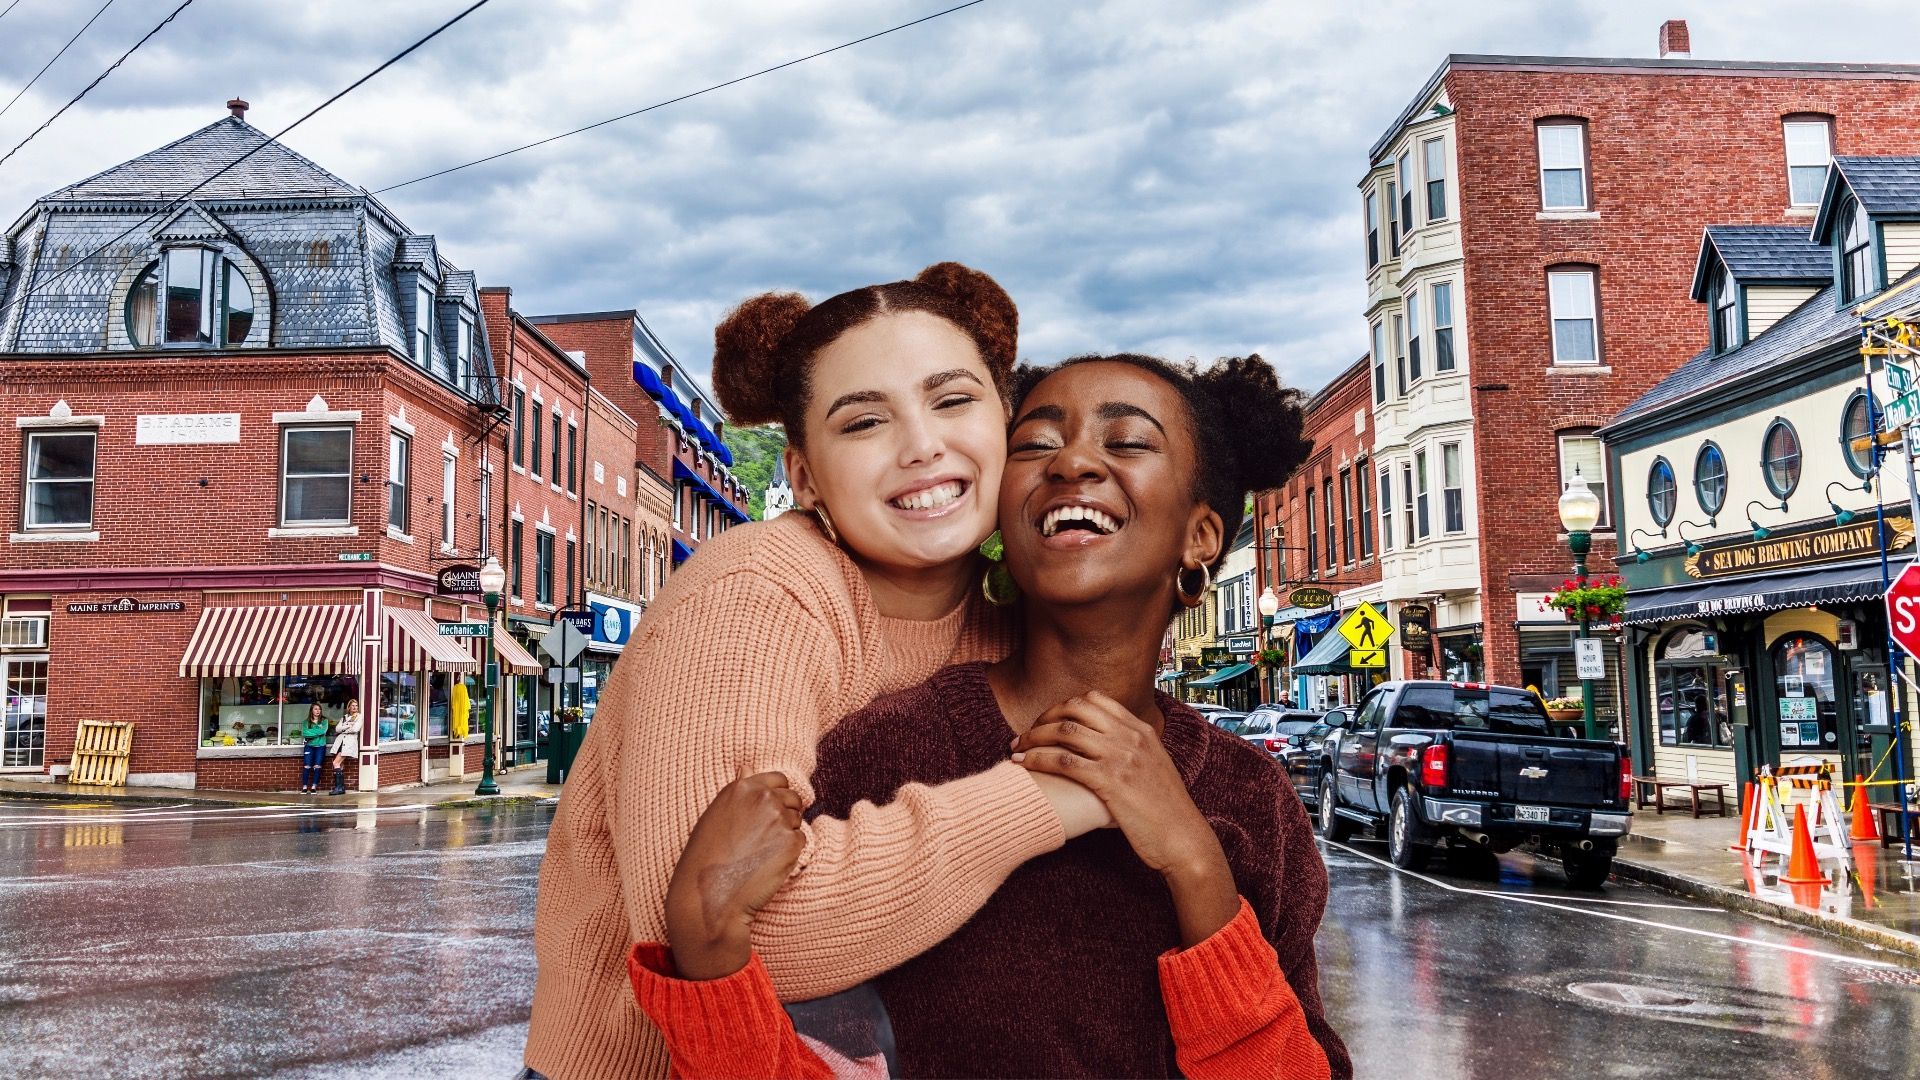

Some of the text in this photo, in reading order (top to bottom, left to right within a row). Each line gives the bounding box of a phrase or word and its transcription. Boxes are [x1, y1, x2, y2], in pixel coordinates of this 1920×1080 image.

[1886, 364, 1912, 391] Elm St
[1886, 393, 1920, 428] Main St
[1713, 527, 1873, 570] SEA DOG BREWING COMPANY
[451, 571, 480, 579] MAINE
[451, 579, 479, 587] STREET
[1291, 594, 1332, 602] COLONY
[69, 602, 180, 612] MAINE STREET IMPRINTS
[1698, 594, 1766, 613] SEA DOG BREWING CO.
[575, 618, 592, 626] BAGS
[440, 624, 487, 635] Mechanic St
[1583, 643, 1593, 651] TWO
[1583, 654, 1596, 662] HOUR
[1579, 665, 1601, 673] PARKING
[1452, 788, 1499, 797] SILVERADO
